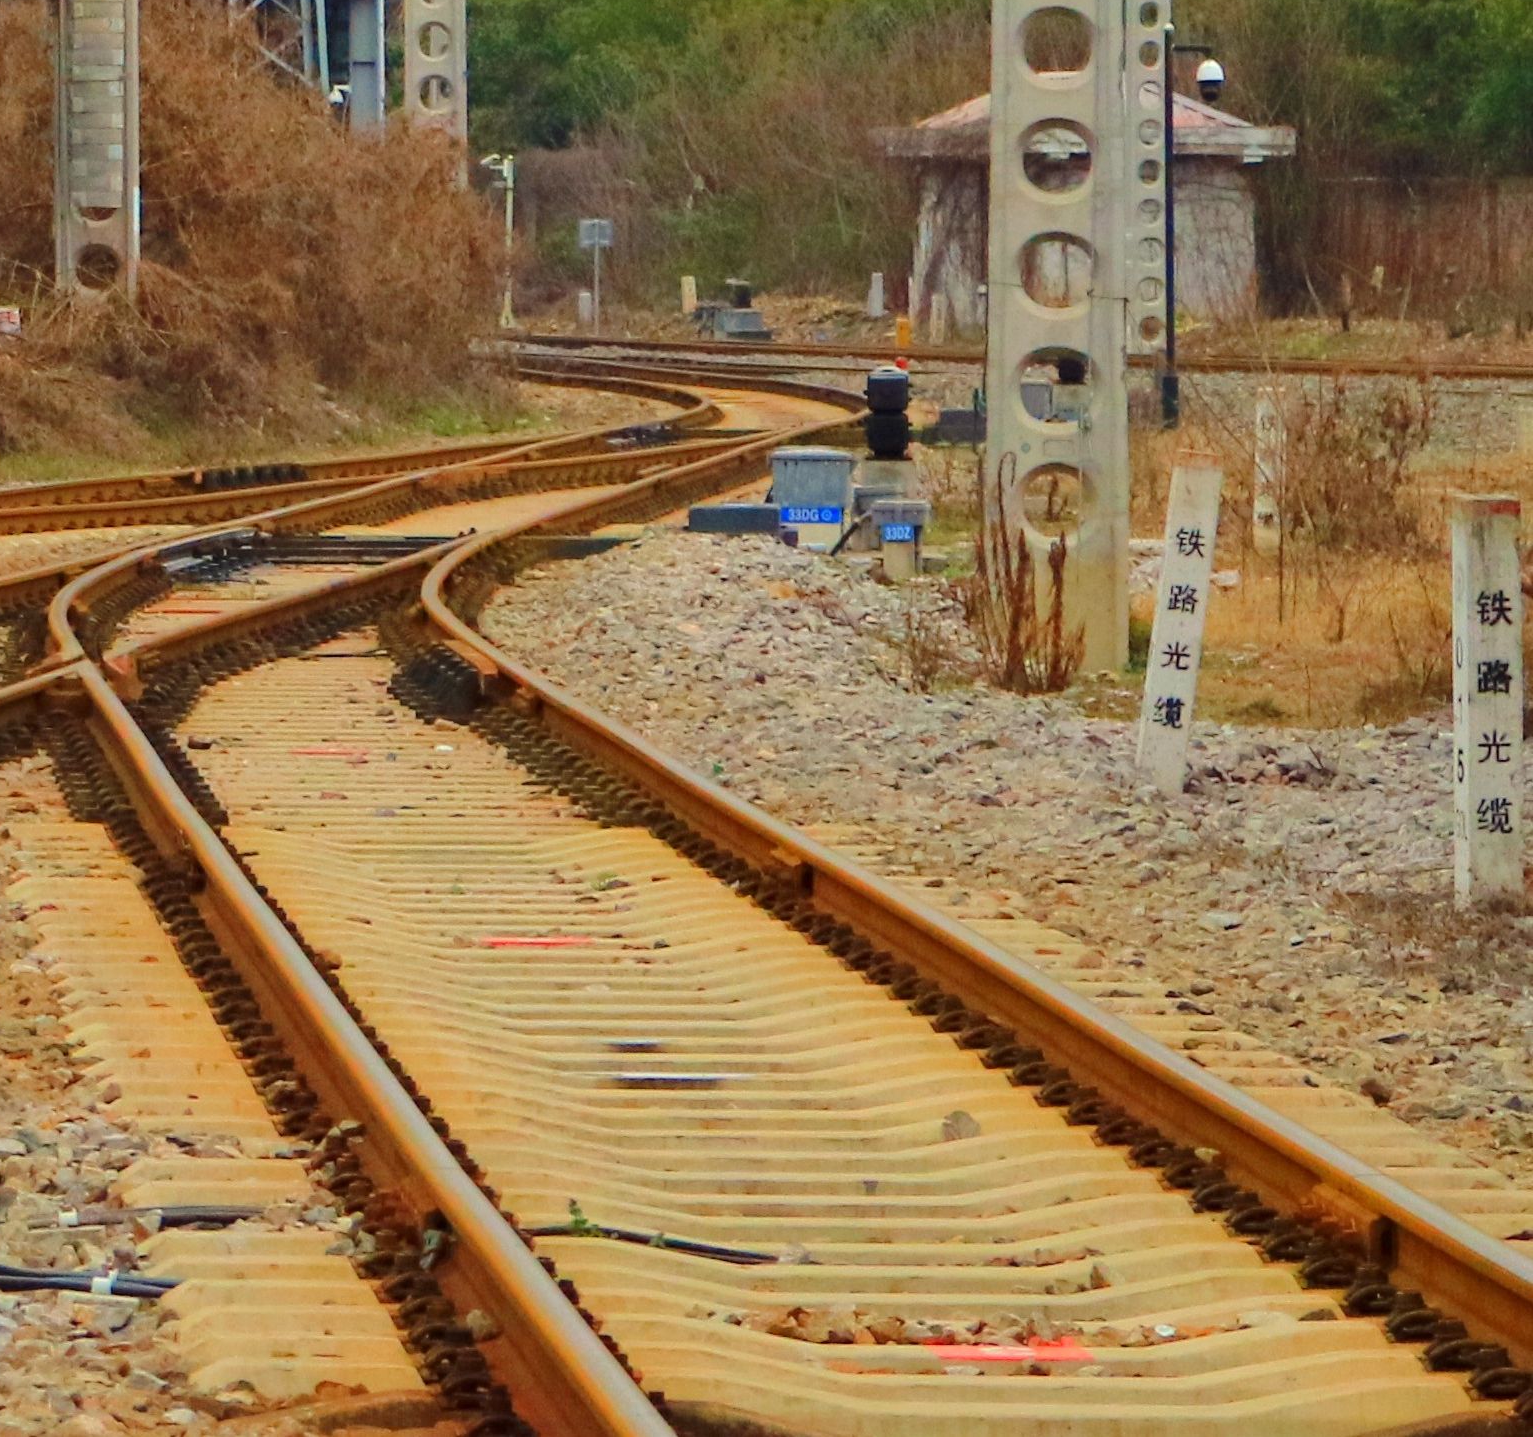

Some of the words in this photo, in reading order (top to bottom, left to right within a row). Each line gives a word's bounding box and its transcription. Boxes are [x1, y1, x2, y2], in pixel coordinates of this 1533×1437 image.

[788, 508, 820, 522] 33DG
[1151, 526, 1207, 730] 铁路光缆
[1475, 589, 1514, 835] 铁路光缆
